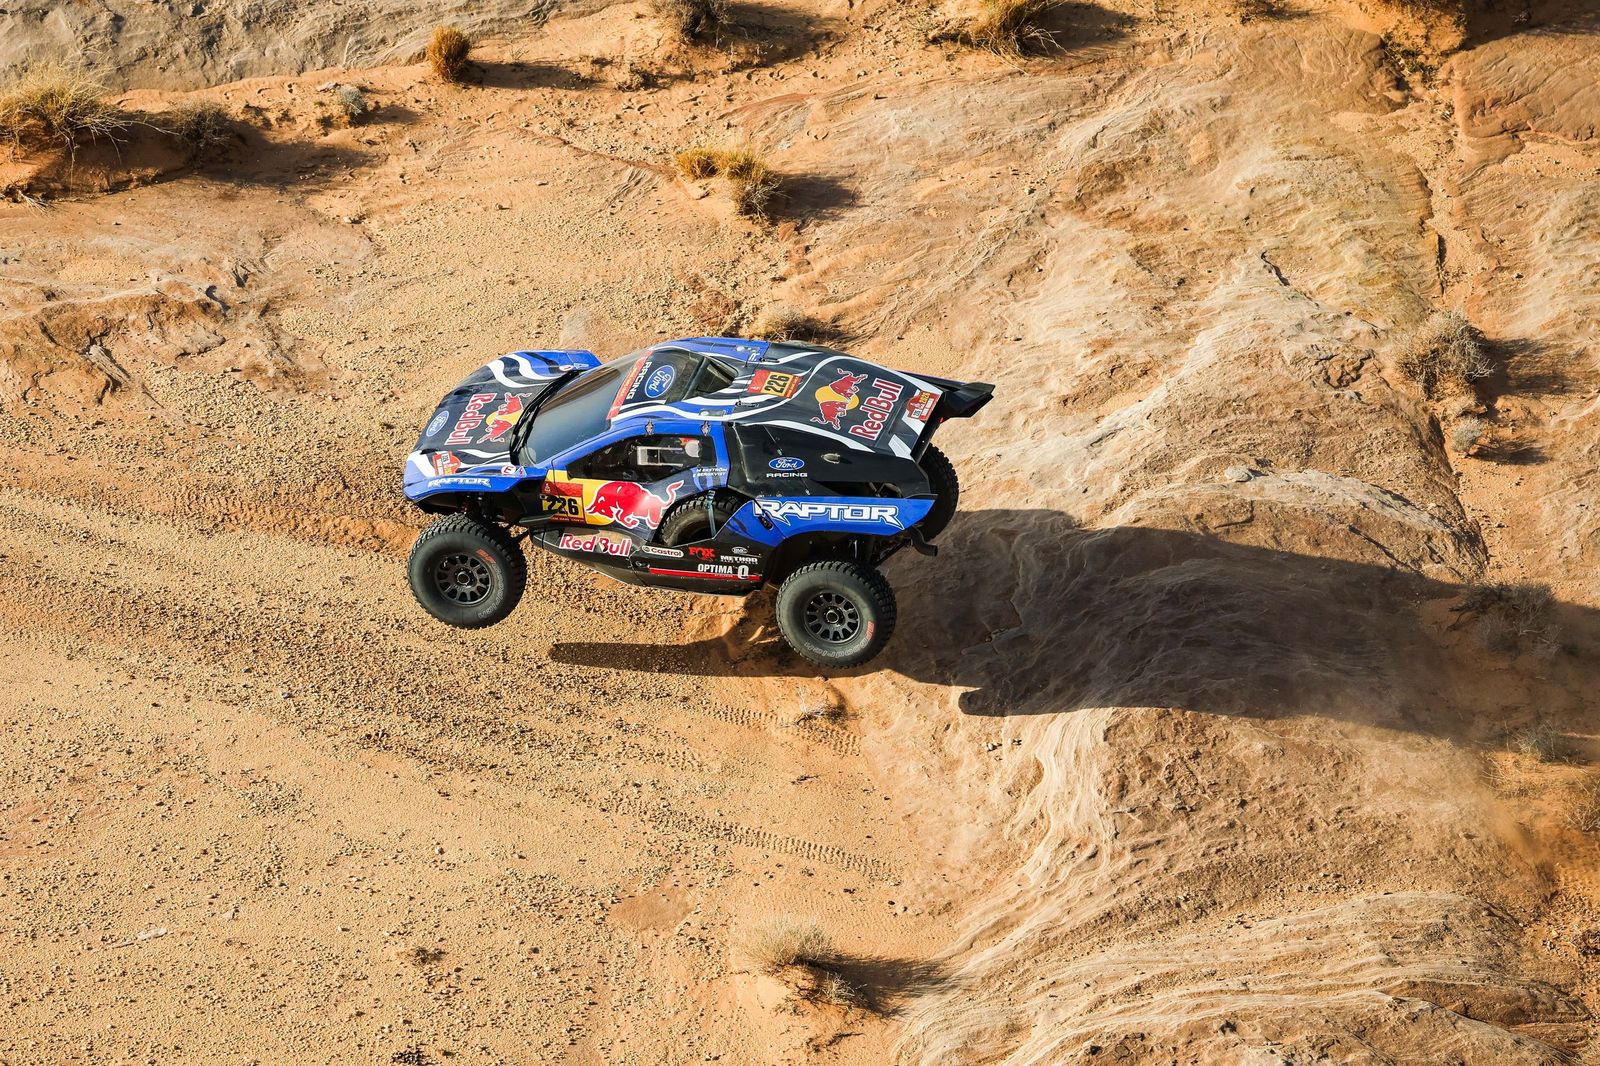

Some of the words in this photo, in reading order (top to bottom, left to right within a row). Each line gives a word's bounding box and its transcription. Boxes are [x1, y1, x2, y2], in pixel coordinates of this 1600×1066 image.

[626, 361, 652, 400] RACING
[648, 369, 672, 393] Ford
[764, 374, 790, 394] 226
[774, 458, 800, 469] Ford
[428, 478, 491, 488] RAPTOR
[545, 495, 579, 515] 226
[752, 500, 905, 530] RAPTOR
[651, 547, 682, 557] Castrol
[688, 546, 715, 558] FOX
[697, 563, 733, 574] OPTIMA
